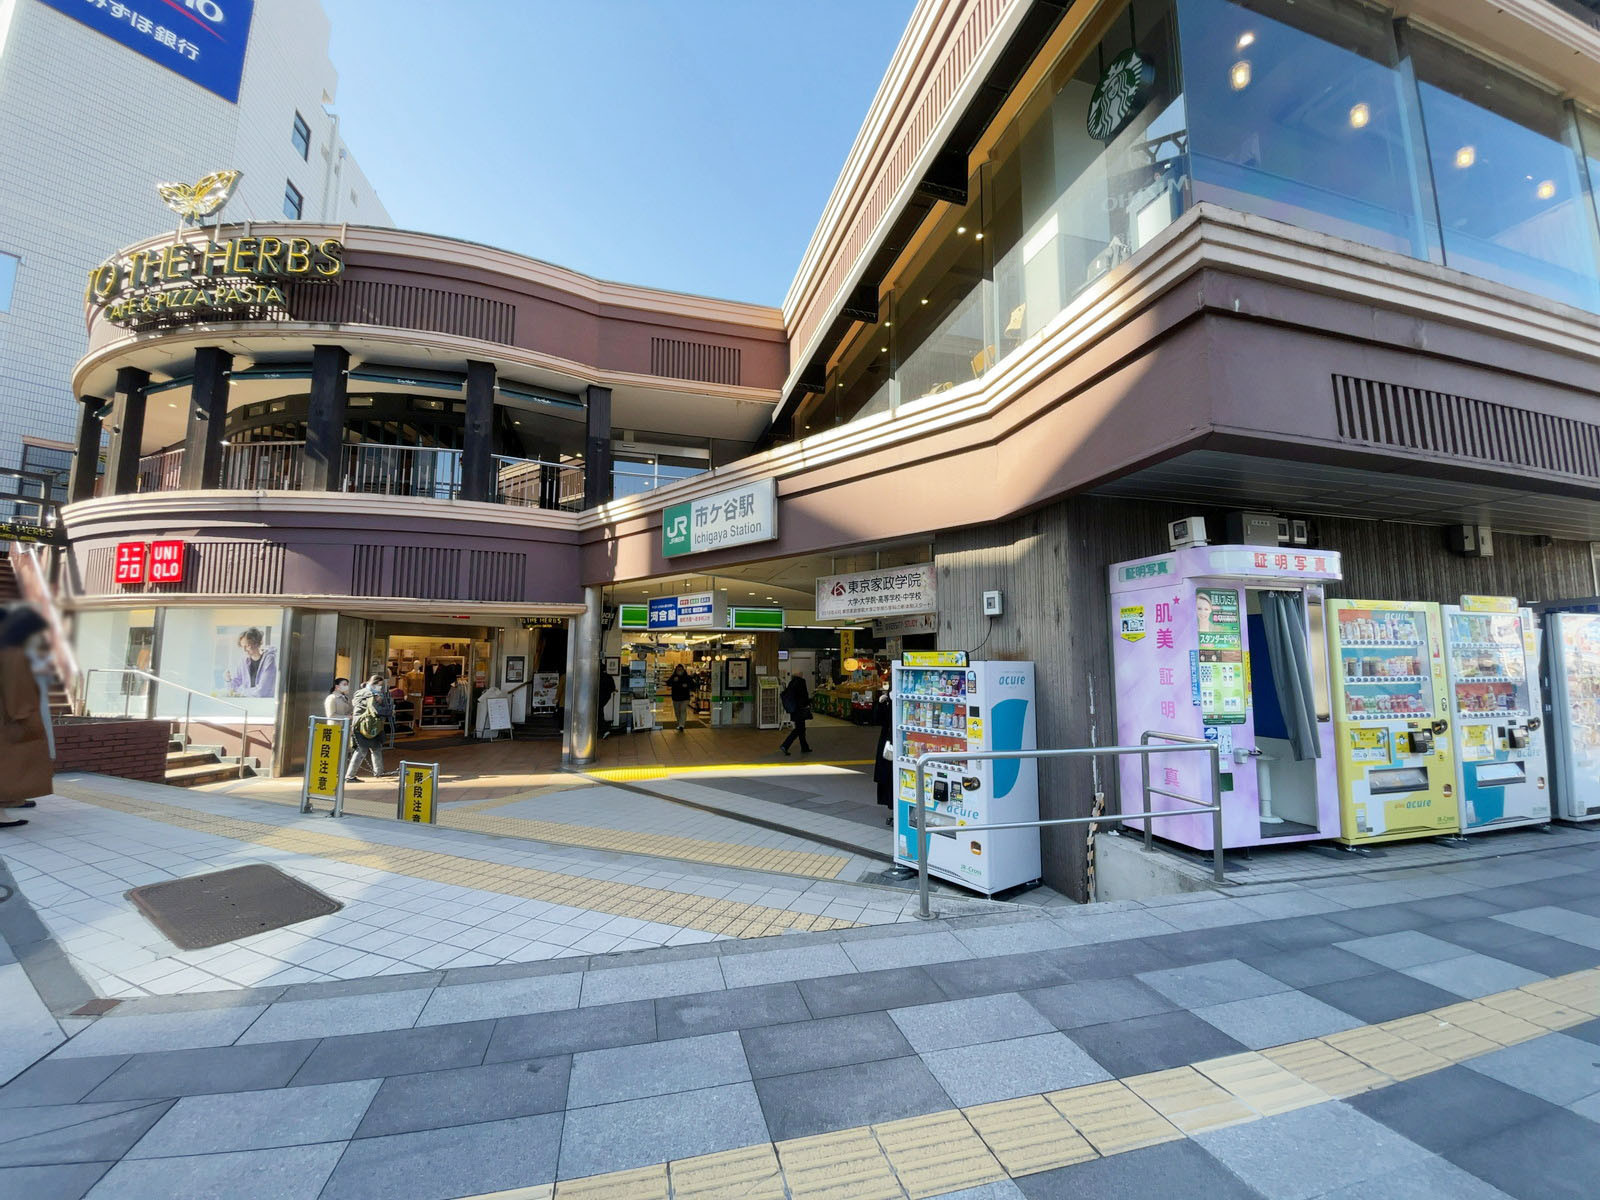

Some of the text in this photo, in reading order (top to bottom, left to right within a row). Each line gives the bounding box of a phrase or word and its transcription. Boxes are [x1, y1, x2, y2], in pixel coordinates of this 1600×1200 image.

[87, 237, 342, 302] TO THE HERBS
[142, 298, 152, 312] &
[156, 289, 209, 308] PIZZA
[216, 286, 284, 303] PASTA
[667, 516, 688, 538] JR
[695, 529, 728, 544] Ichigaya
[730, 522, 762, 537] Station
[120, 547, 141, 562] ユニ
[154, 546, 178, 560] UNI
[1254, 552, 1327, 572] 証明写真
[118, 564, 140, 578] クロ
[153, 562, 179, 579] QLO
[1126, 561, 1168, 579] 証明写真
[848, 573, 921, 594] 東京家政学院
[999, 675, 1026, 685] acure
[318, 728, 332, 791] 階段注意
[946, 802, 980, 820] acure
[1406, 800, 1432, 809] acure
